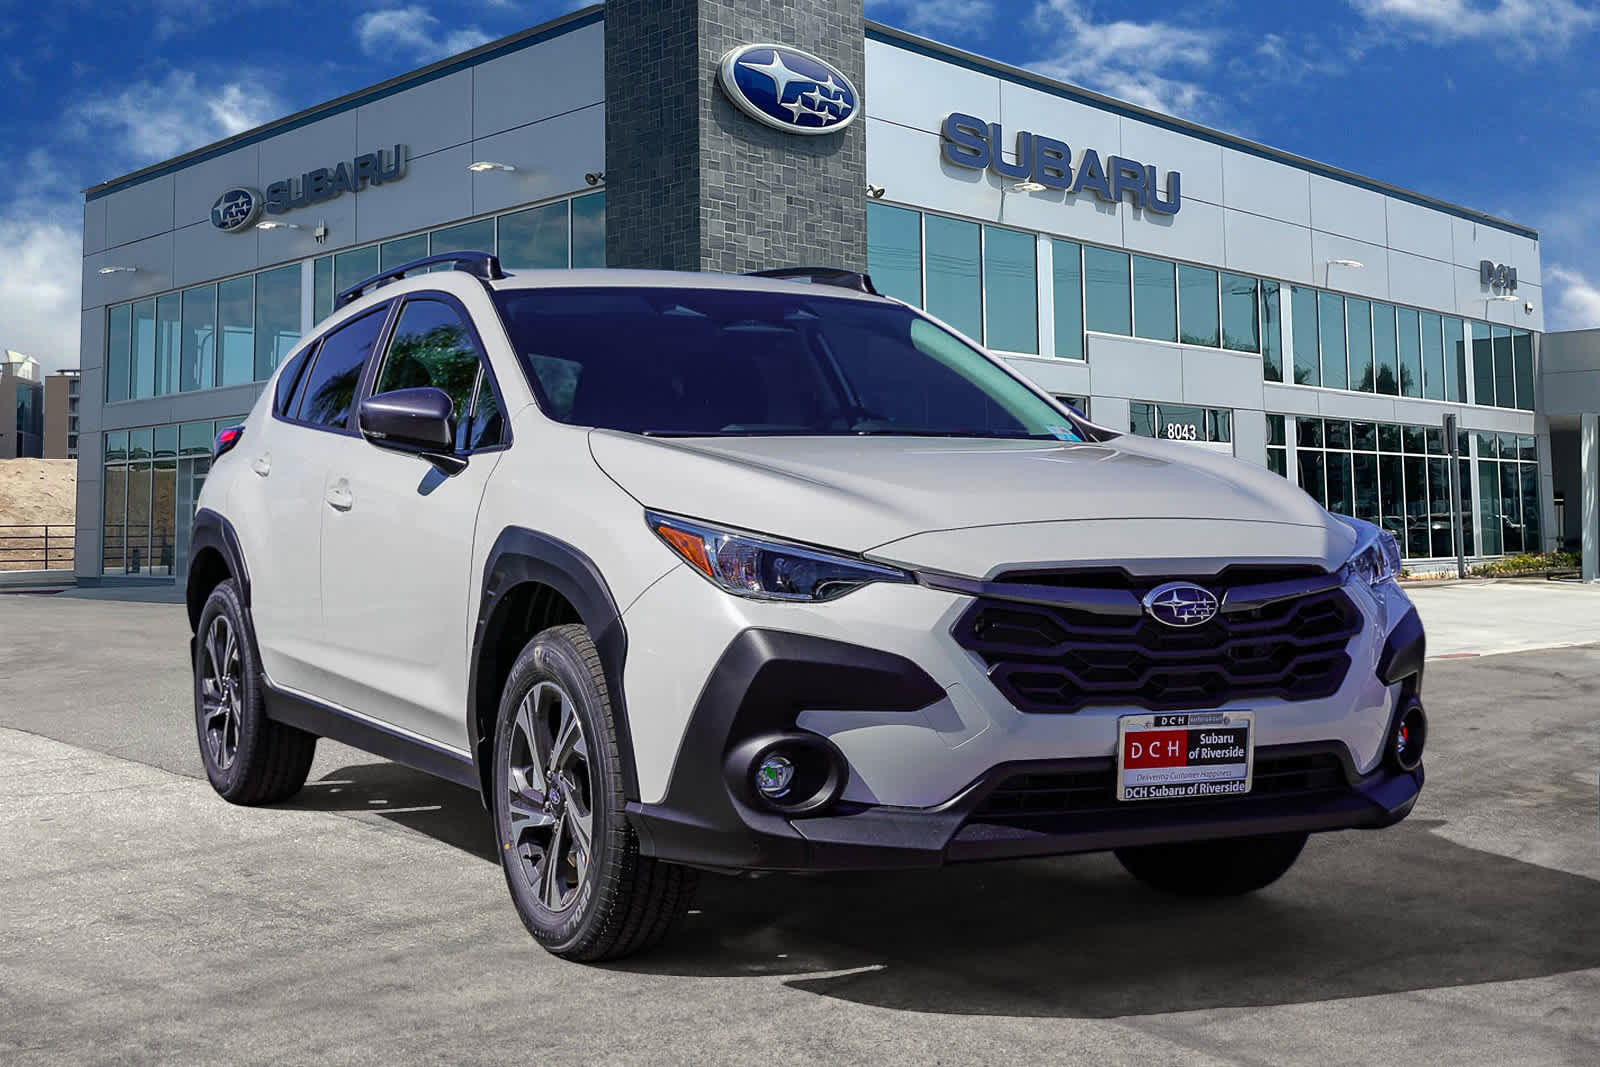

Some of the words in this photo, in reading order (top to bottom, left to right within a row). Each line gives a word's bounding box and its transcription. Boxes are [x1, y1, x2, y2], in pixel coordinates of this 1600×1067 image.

[943, 112, 1181, 215] SUBARU
[266, 143, 407, 215] SUBARU
[1167, 423, 1197, 440] 8043
[1161, 717, 1185, 726] DCH
[1200, 733, 1234, 745] Subaru
[1131, 740, 1179, 759] DCH
[1188, 748, 1200, 759] of
[1200, 746, 1245, 759] Riverside
[1125, 787, 1147, 799] DCH
[1149, 785, 1185, 797] Subaru
[1188, 783, 1198, 794] of
[1200, 780, 1245, 793] Riverside
